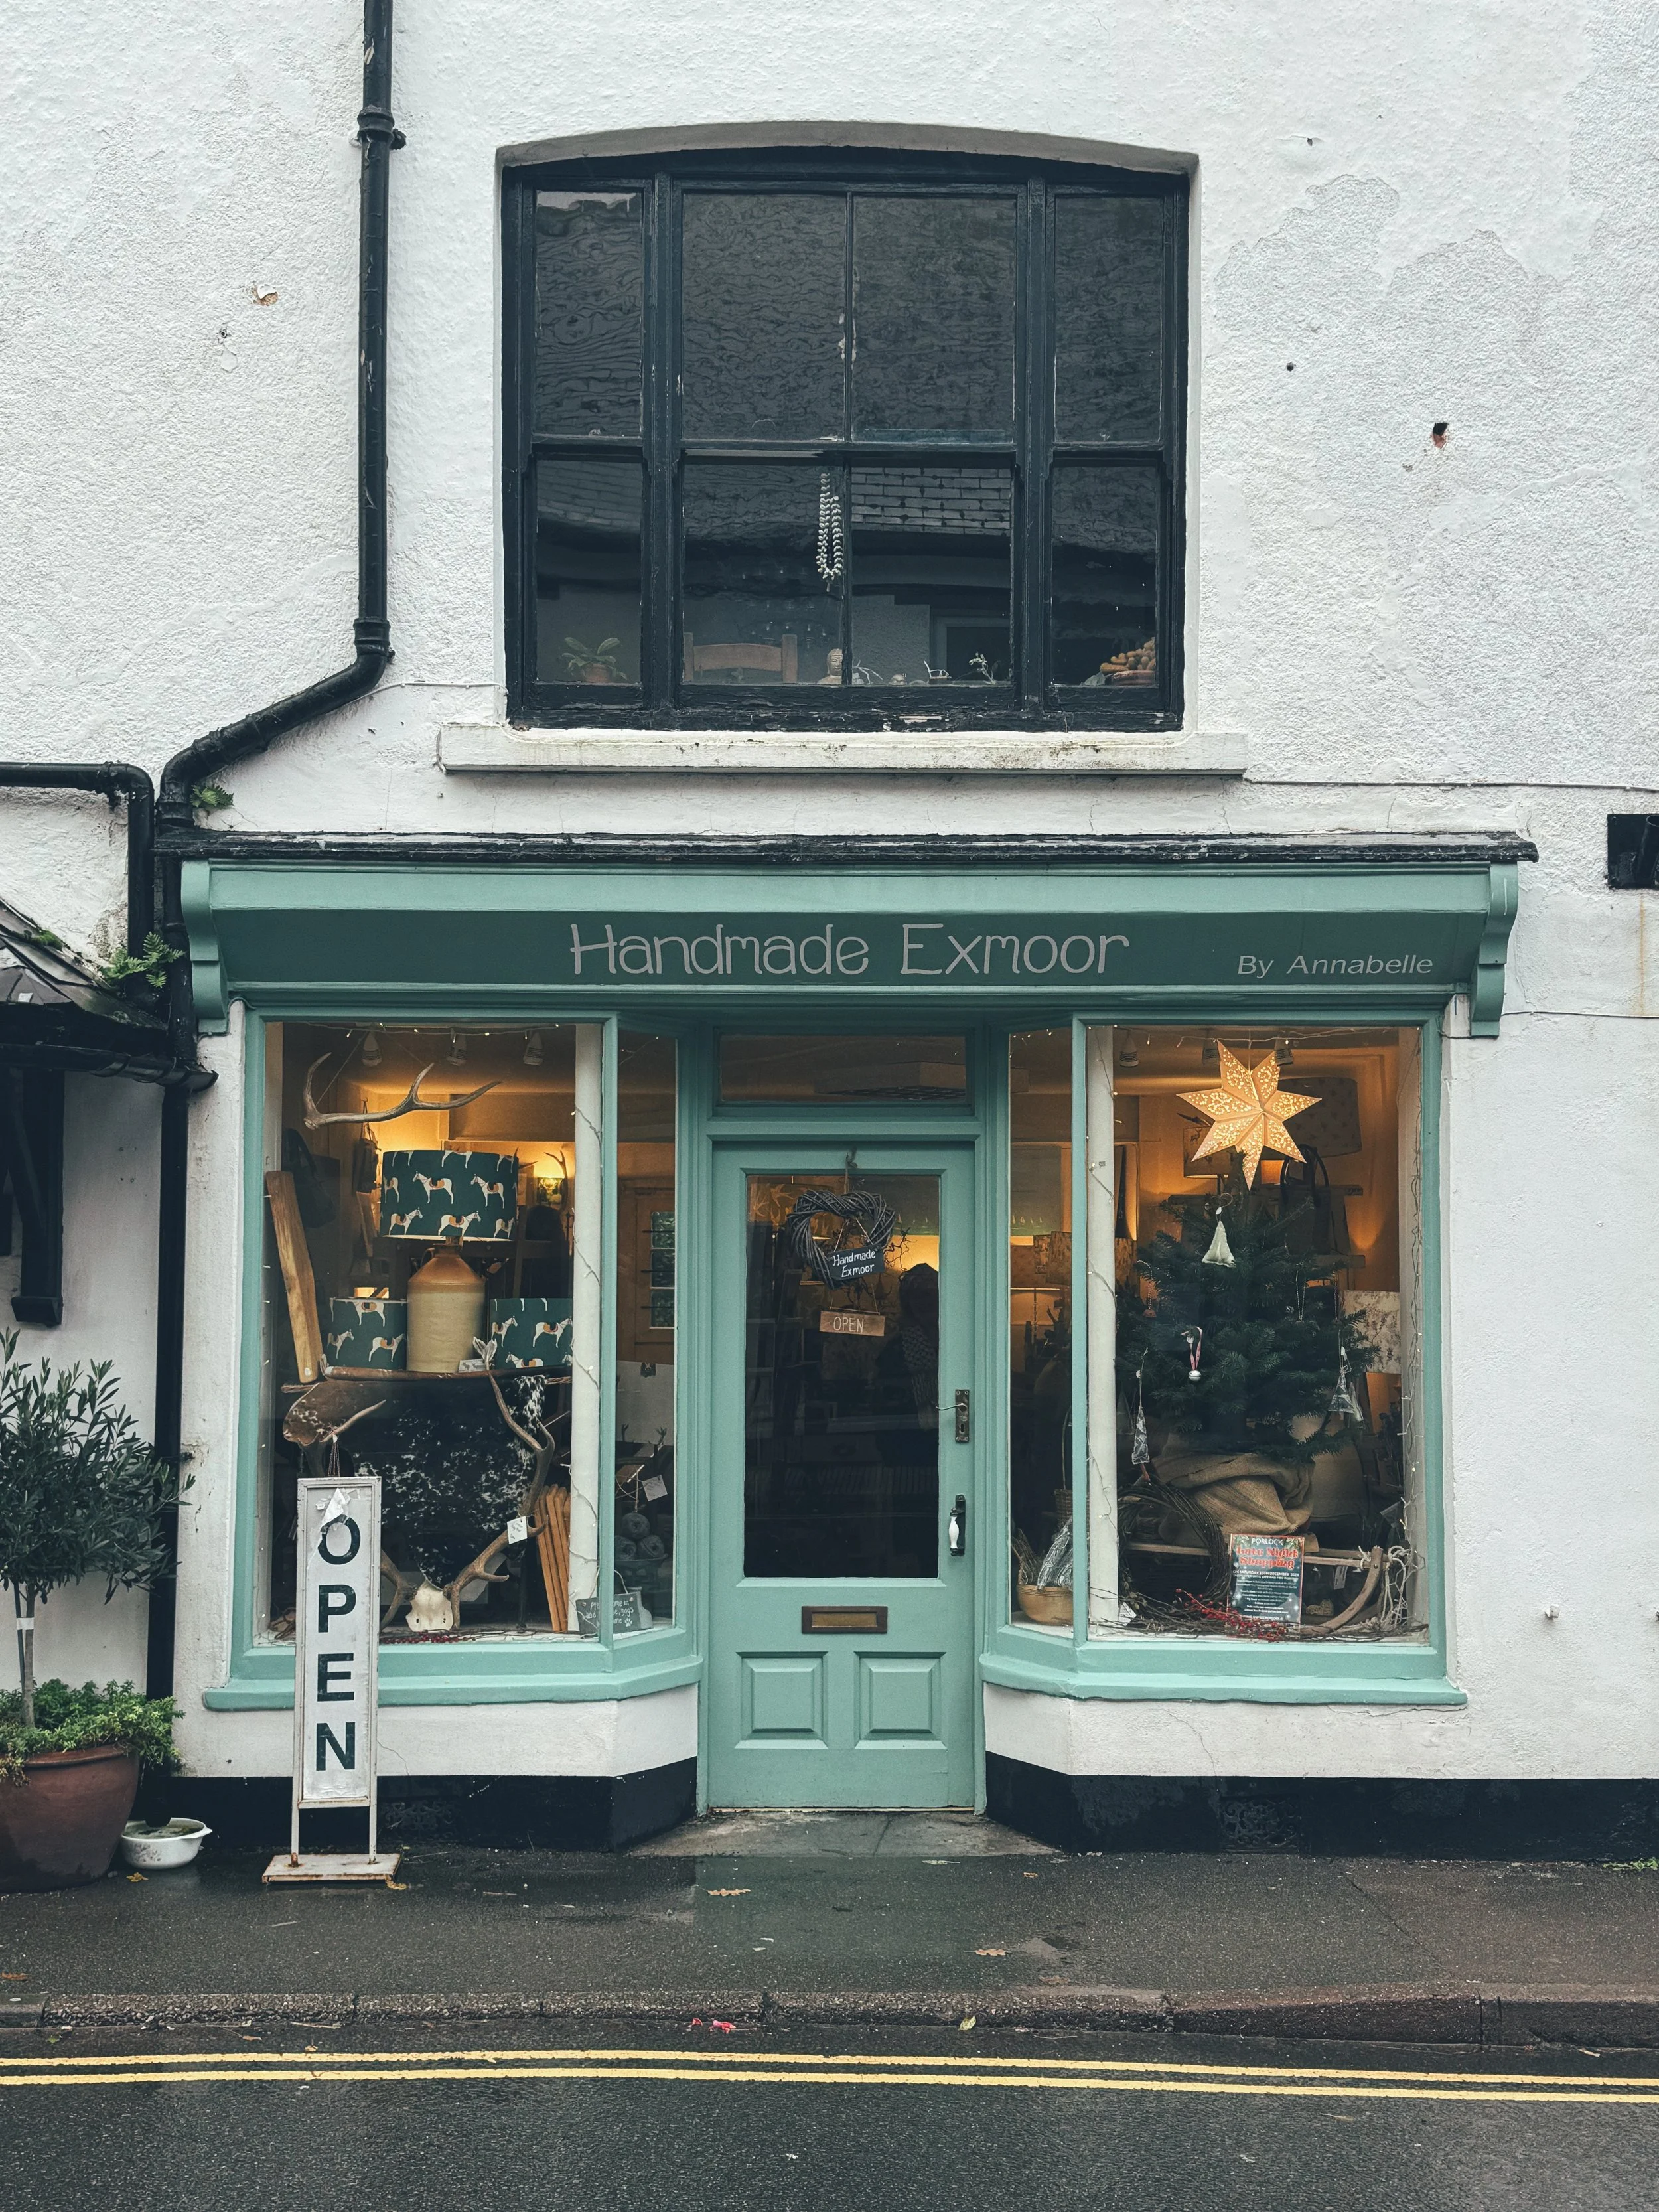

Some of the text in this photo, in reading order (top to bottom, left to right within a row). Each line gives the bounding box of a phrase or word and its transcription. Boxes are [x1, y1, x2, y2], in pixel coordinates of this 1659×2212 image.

[570, 923, 1129, 975] Handmade Exmoor
[1238, 954, 1433, 979] By Annabelle
[841, 1264, 875, 1278] Exmoor
[833, 1317, 864, 1333] OPEN
[1252, 1537, 1283, 1546] PORLOCK
[1236, 1545, 1299, 1559] Late Night
[1239, 1556, 1295, 1571] Shopping
[316, 1514, 360, 1771] OPEN
